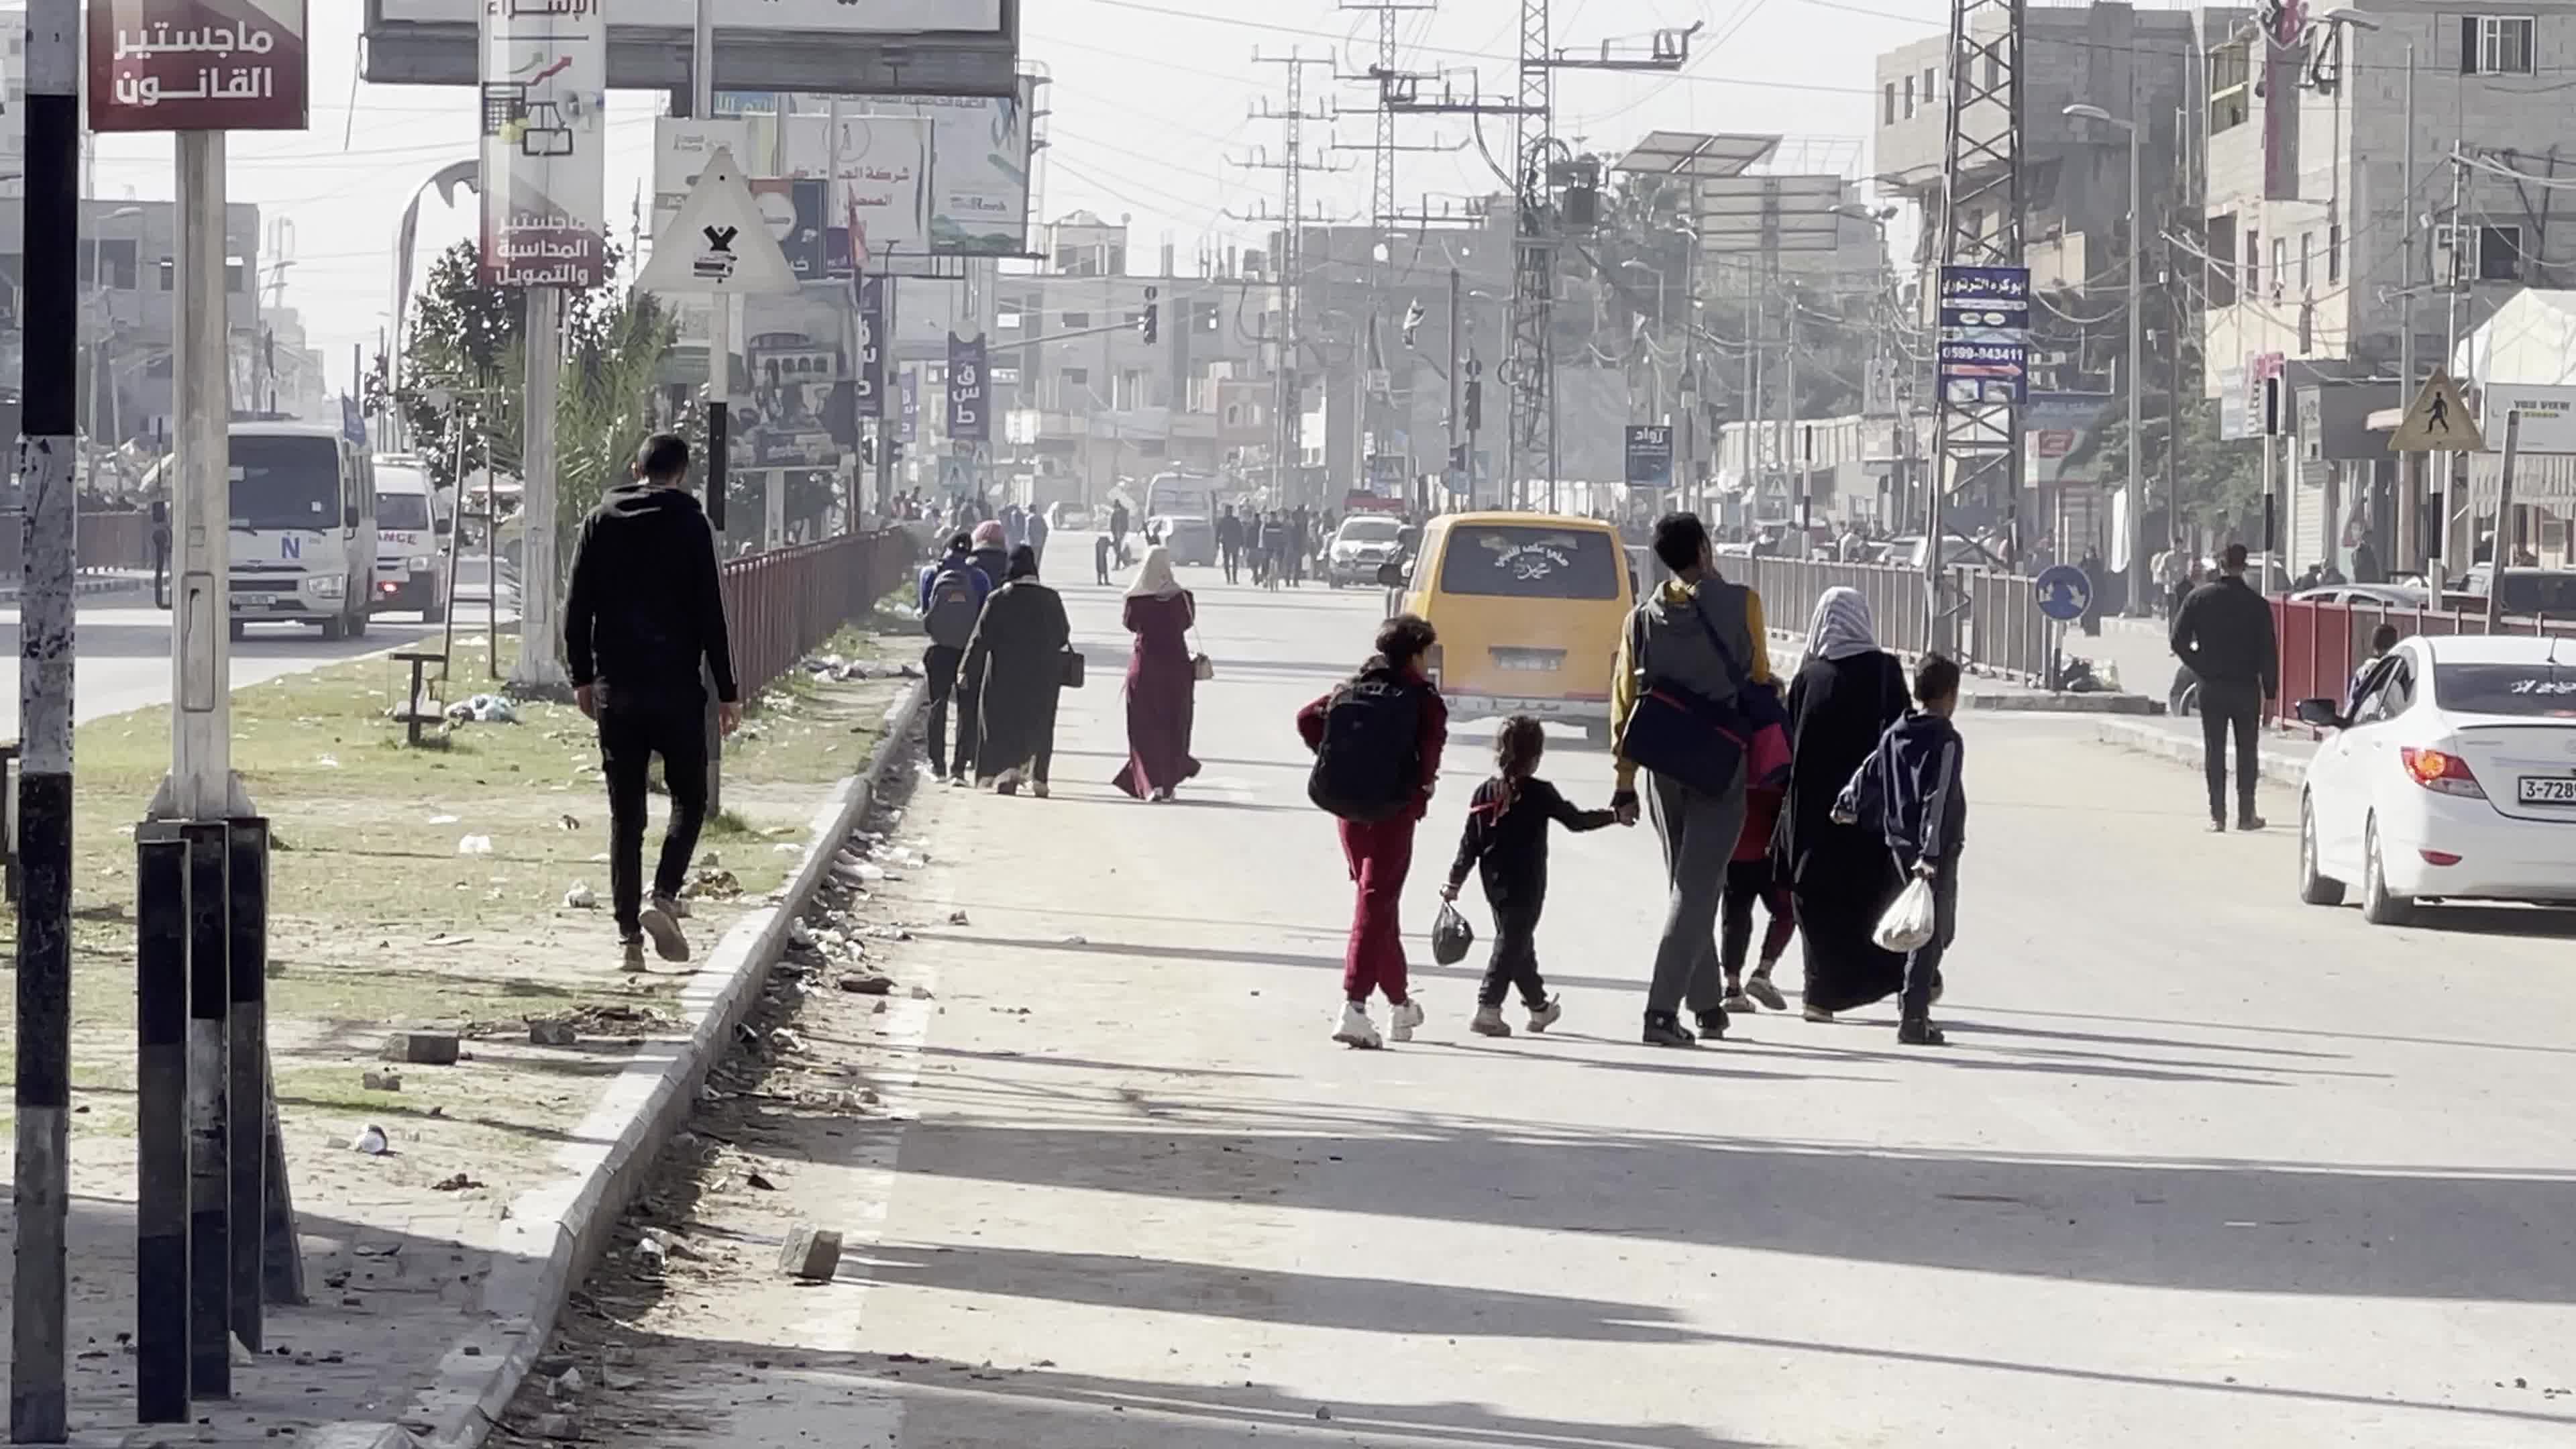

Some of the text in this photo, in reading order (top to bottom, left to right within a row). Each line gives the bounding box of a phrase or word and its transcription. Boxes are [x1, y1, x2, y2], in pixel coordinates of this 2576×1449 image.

[114, 21, 274, 60] ماجستير
[116, 67, 272, 106] القانون
[498, 213, 587, 235] ماجستير
[497, 239, 589, 261] المحاسبة
[495, 264, 589, 286] والتمويل
[281, 537, 301, 559] N
[2526, 781, 2576, 798] 3-728
